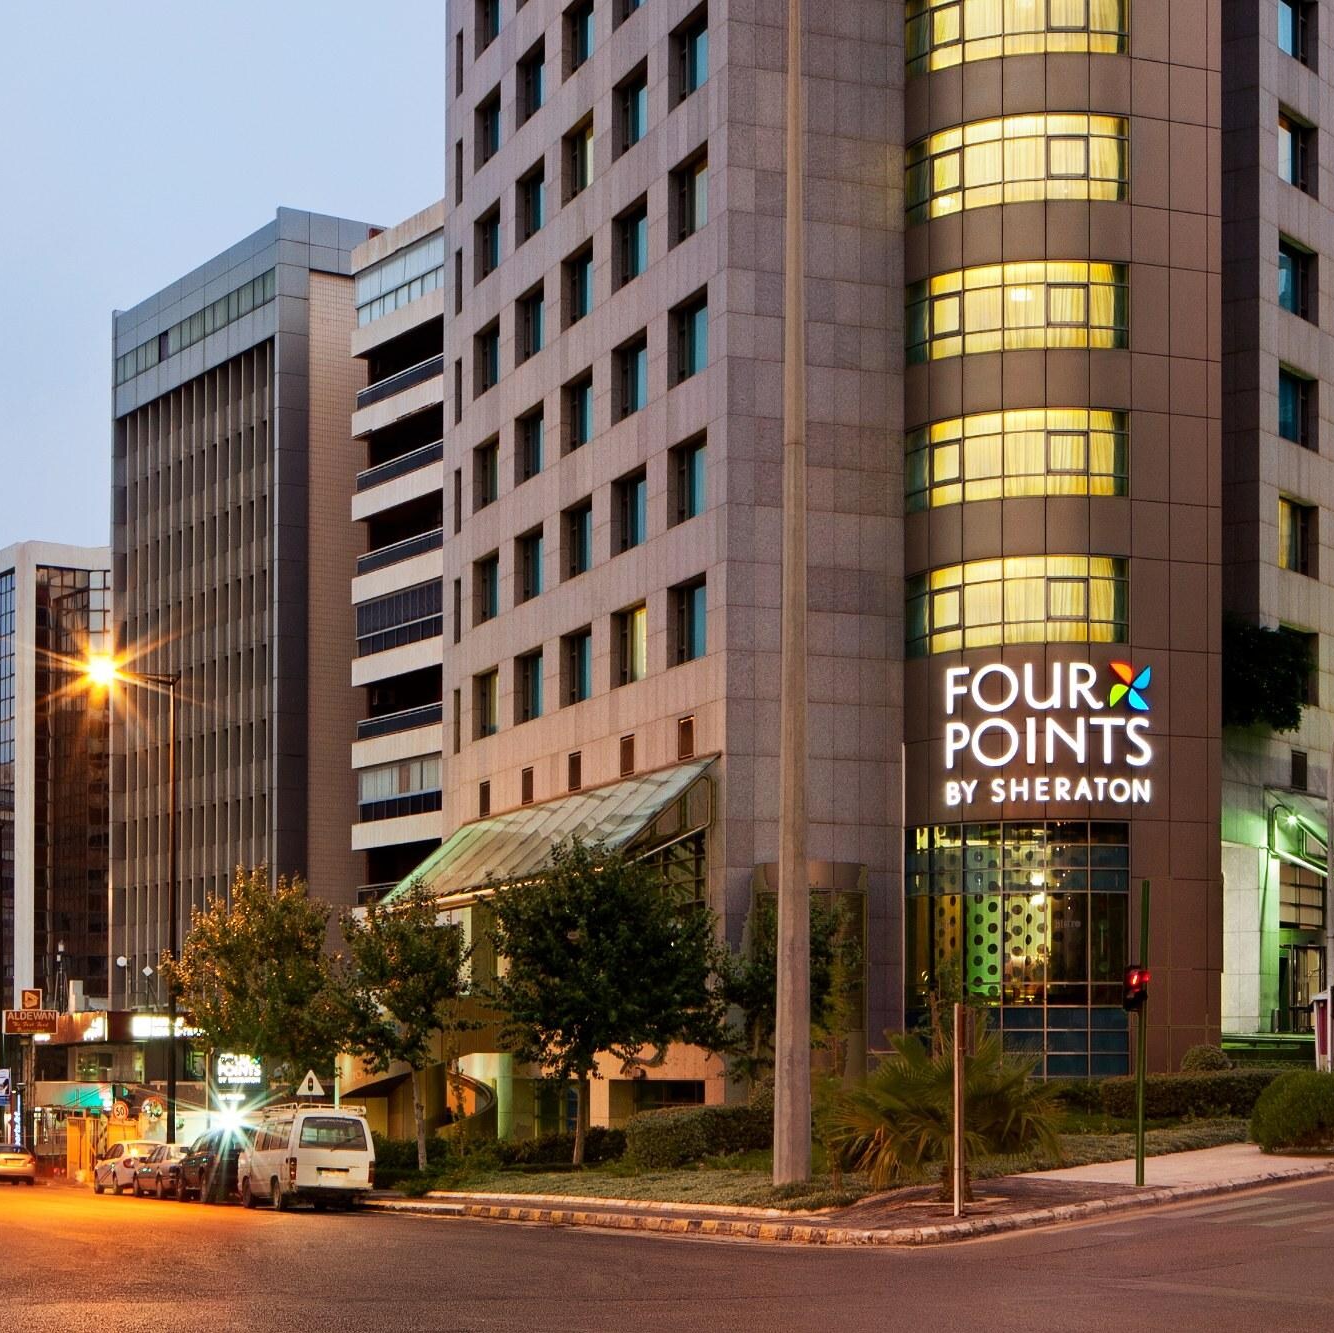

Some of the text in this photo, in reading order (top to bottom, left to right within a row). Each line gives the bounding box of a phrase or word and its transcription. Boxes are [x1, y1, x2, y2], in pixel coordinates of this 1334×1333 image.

[945, 661, 1105, 714] FOUR
[945, 716, 1153, 769] POINTS
[945, 777, 1151, 806] BY SHERATON
[7, 1011, 55, 1021] ALDEWAN
[116, 1106, 125, 1116] 50
